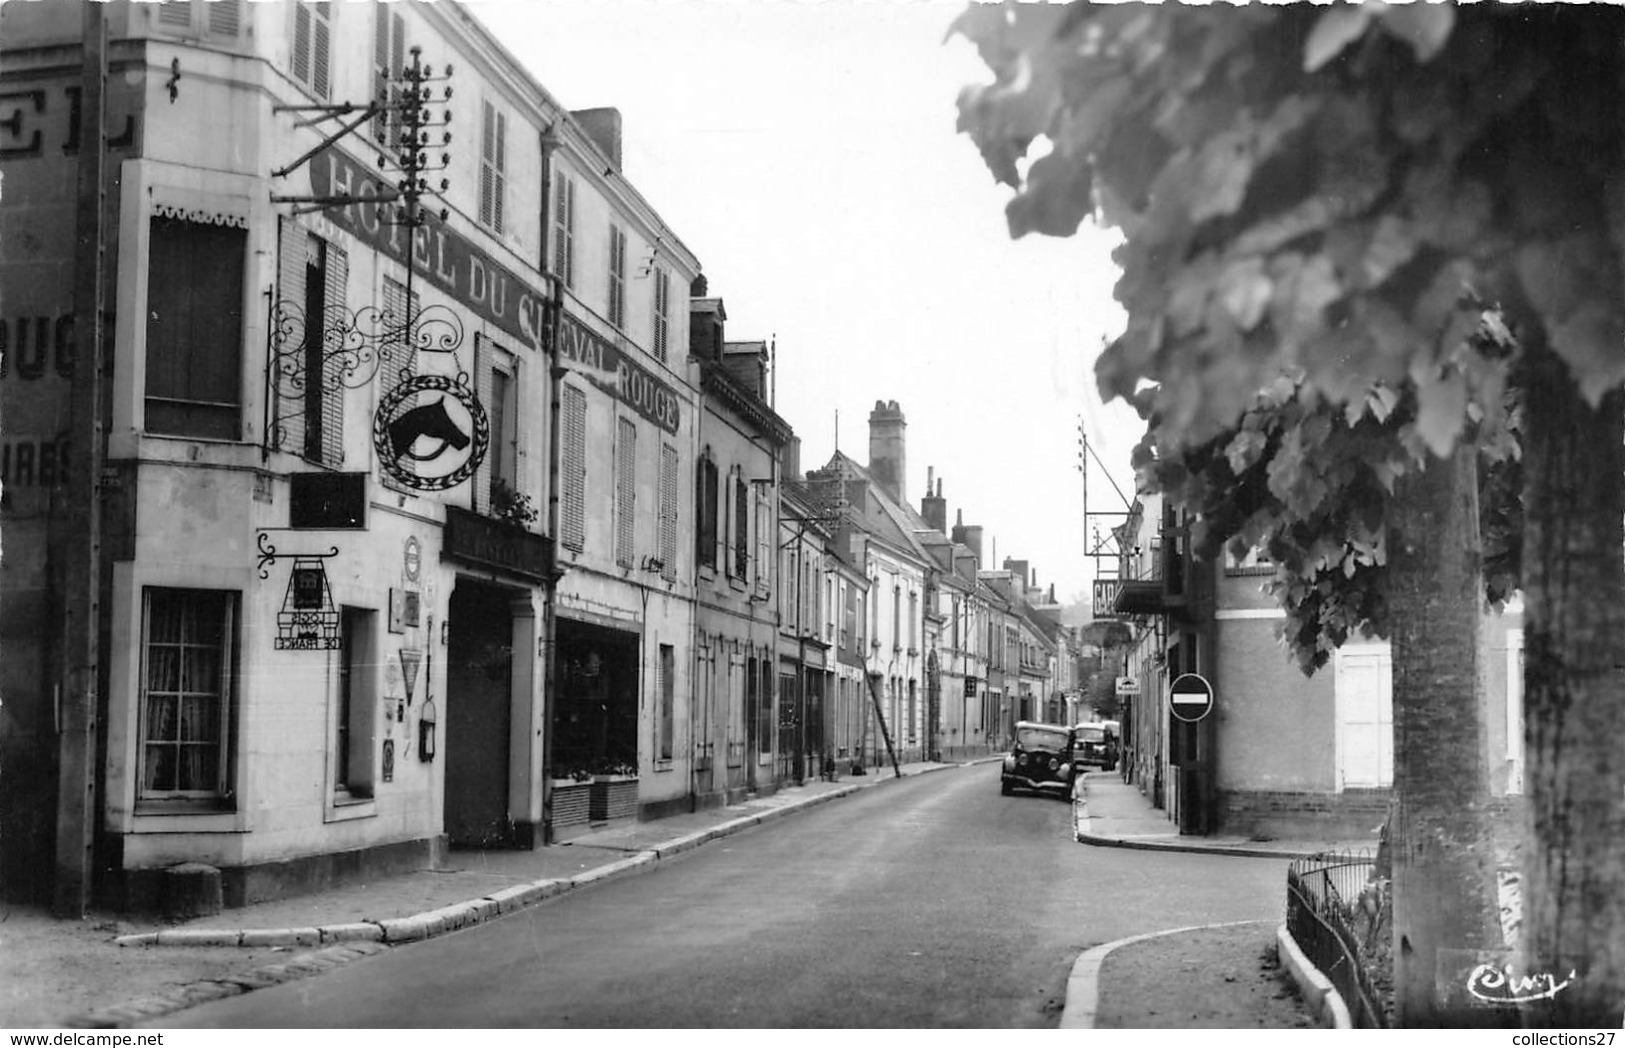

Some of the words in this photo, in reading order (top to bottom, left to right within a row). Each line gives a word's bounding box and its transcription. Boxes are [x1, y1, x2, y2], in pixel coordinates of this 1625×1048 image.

[328, 153, 456, 289] HOTEL
[469, 254, 507, 318] DU
[616, 359, 677, 429] ROUGE
